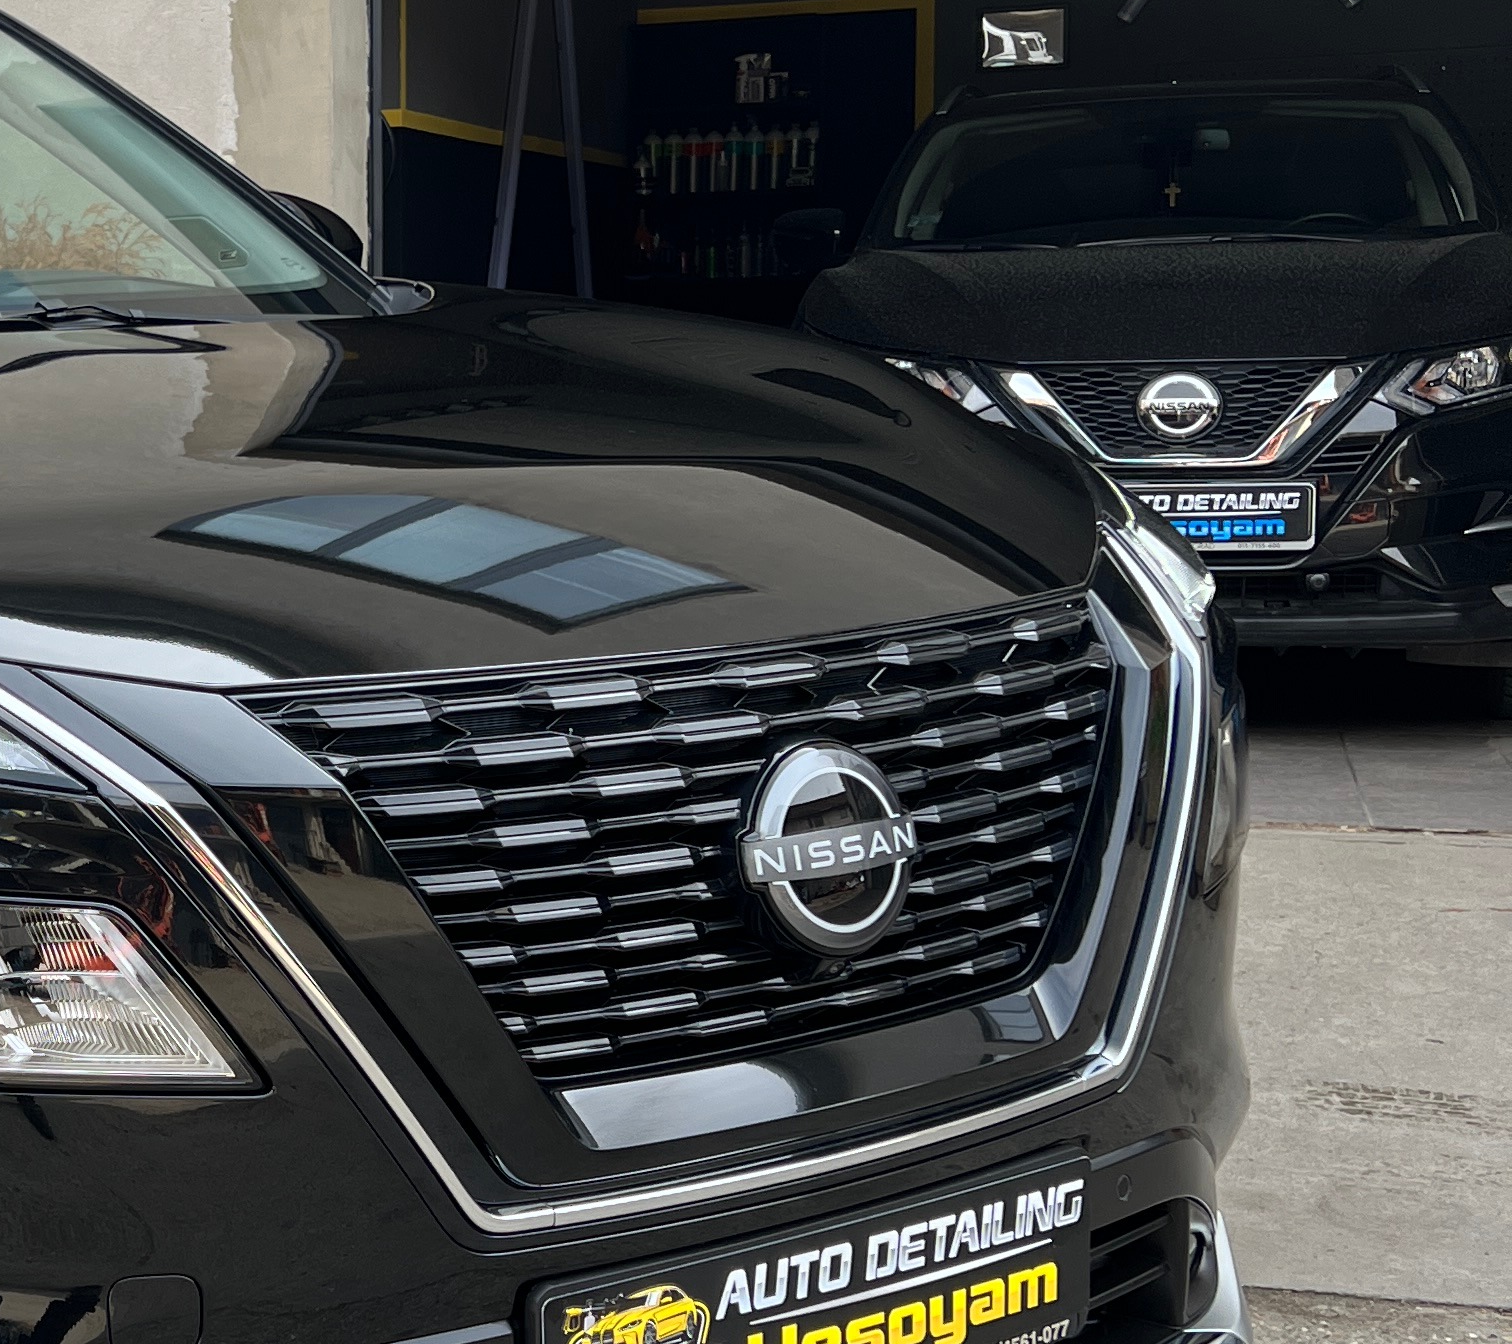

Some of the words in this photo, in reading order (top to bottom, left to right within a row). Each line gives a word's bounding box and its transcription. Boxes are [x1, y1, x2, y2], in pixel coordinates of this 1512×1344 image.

[1150, 401, 1210, 413] NISSAN
[1138, 494, 1172, 511] TO
[1176, 492, 1301, 512] DETAILING
[1170, 518, 1286, 542] soyam
[753, 822, 916, 876] NISSAN
[715, 1241, 853, 1321] AUTO
[865, 1178, 1085, 1282] DETAILING
